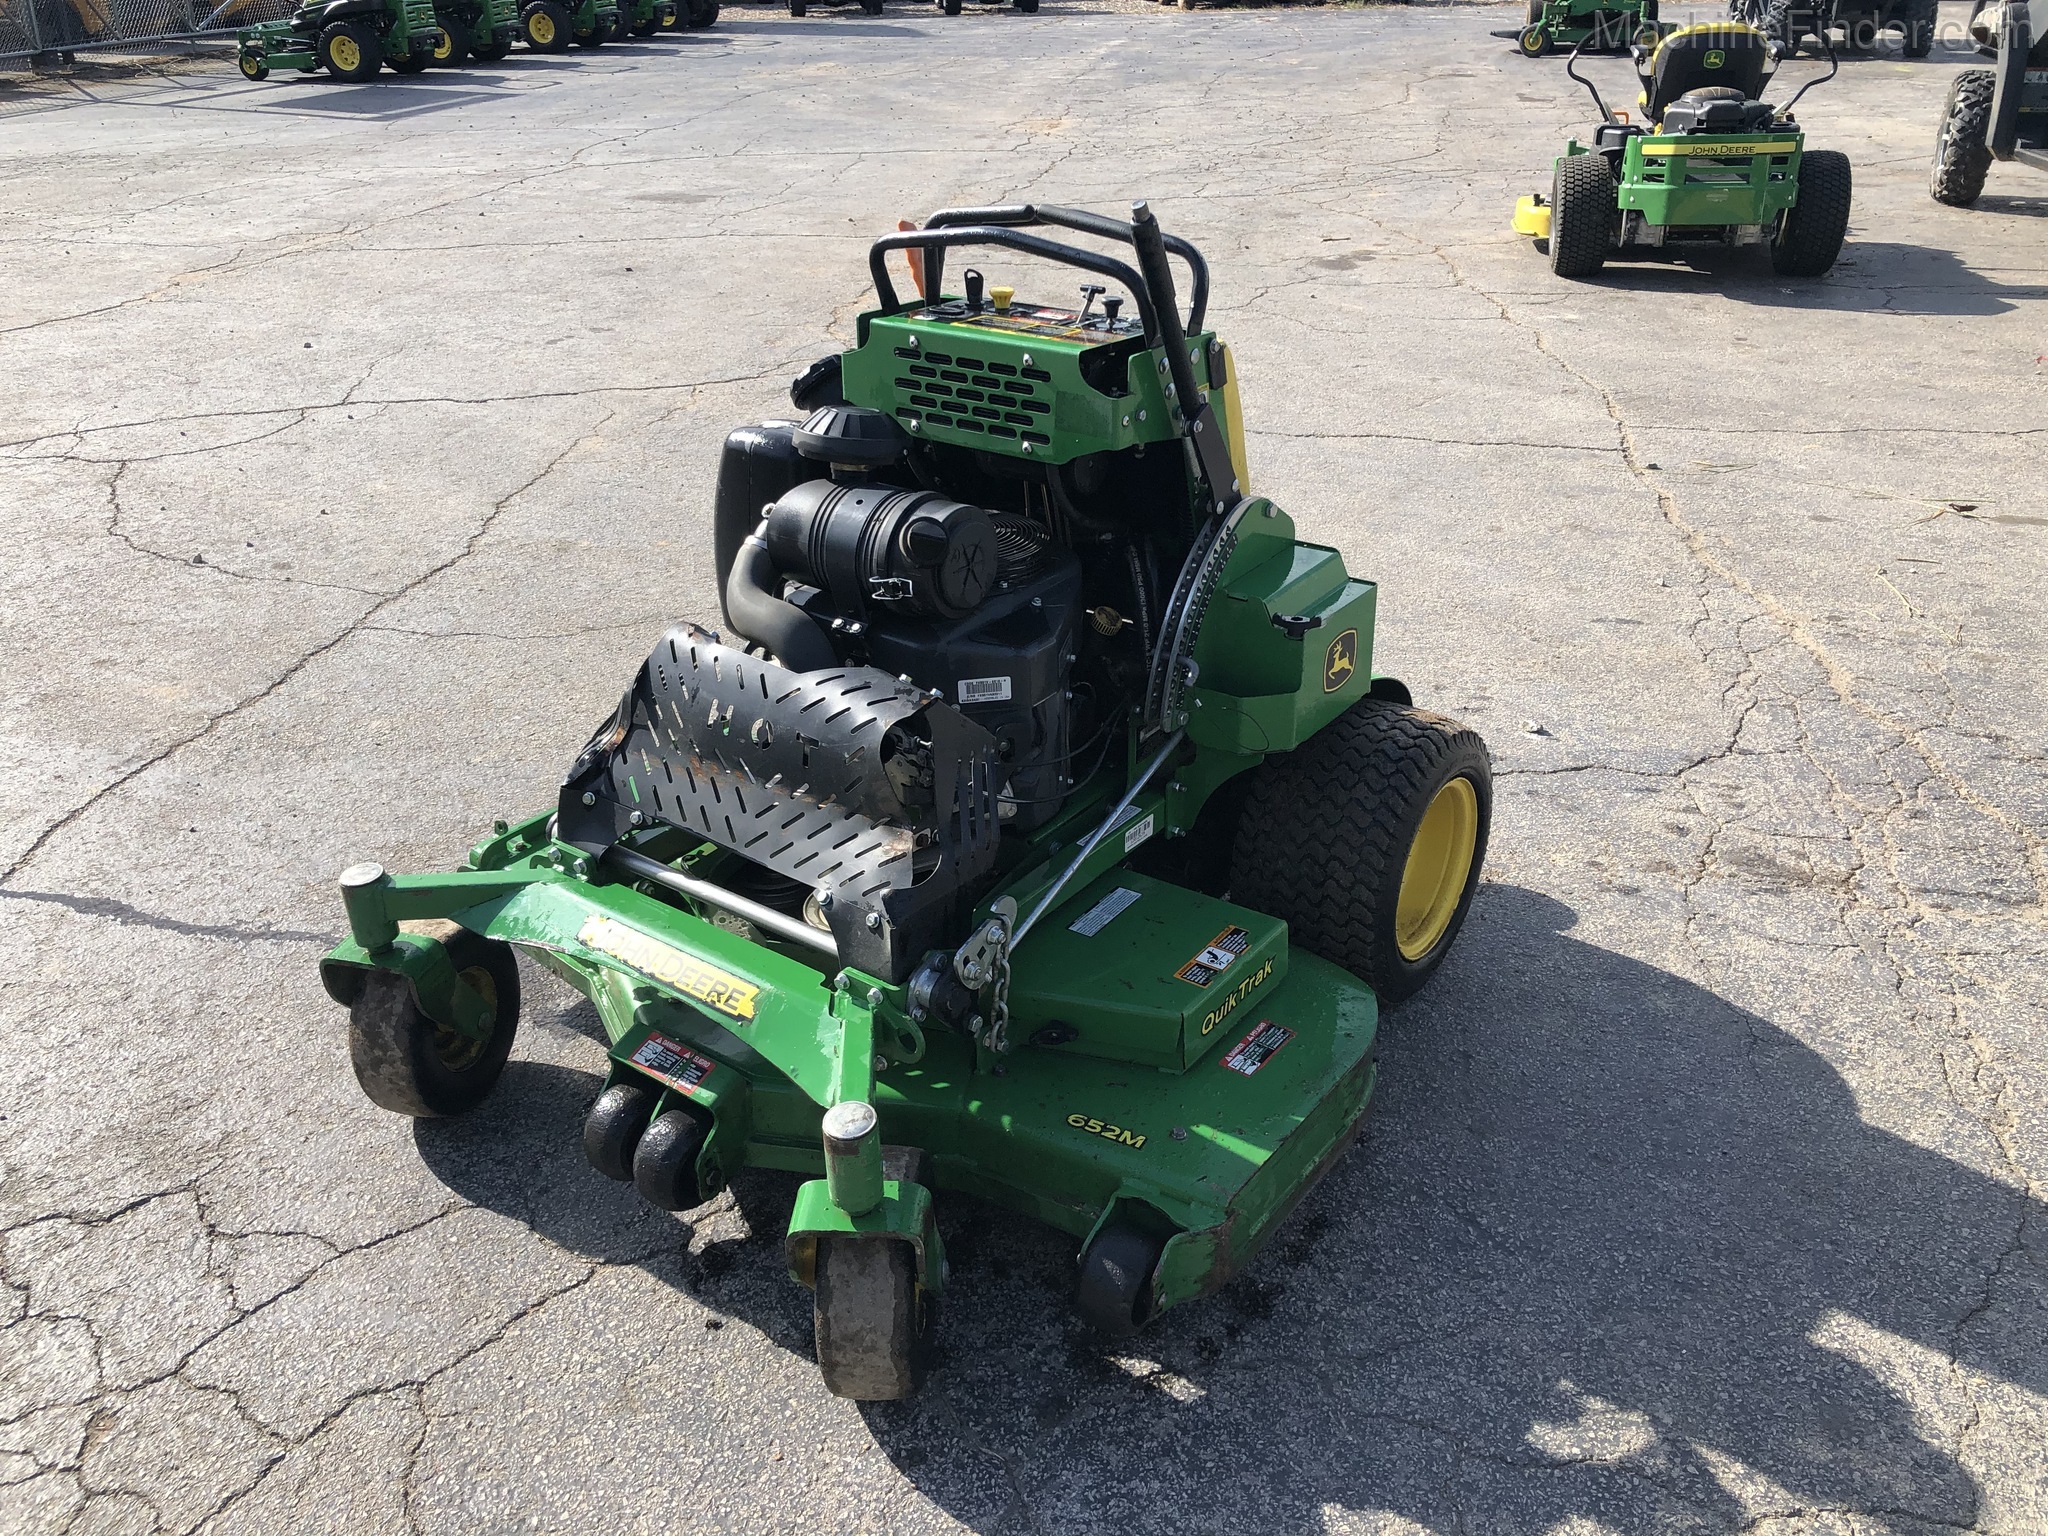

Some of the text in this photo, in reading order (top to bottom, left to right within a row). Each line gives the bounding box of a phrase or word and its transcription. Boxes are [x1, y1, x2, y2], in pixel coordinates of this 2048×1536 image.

[1689, 145, 1756, 155] JOHN DEERE
[706, 697, 820, 769] HOT
[596, 930, 747, 1012] JOHN DEERE
[661, 1039, 682, 1052] DANGER
[690, 1052, 711, 1068] ELIGRO
[1067, 1113, 1146, 1149] 652M
